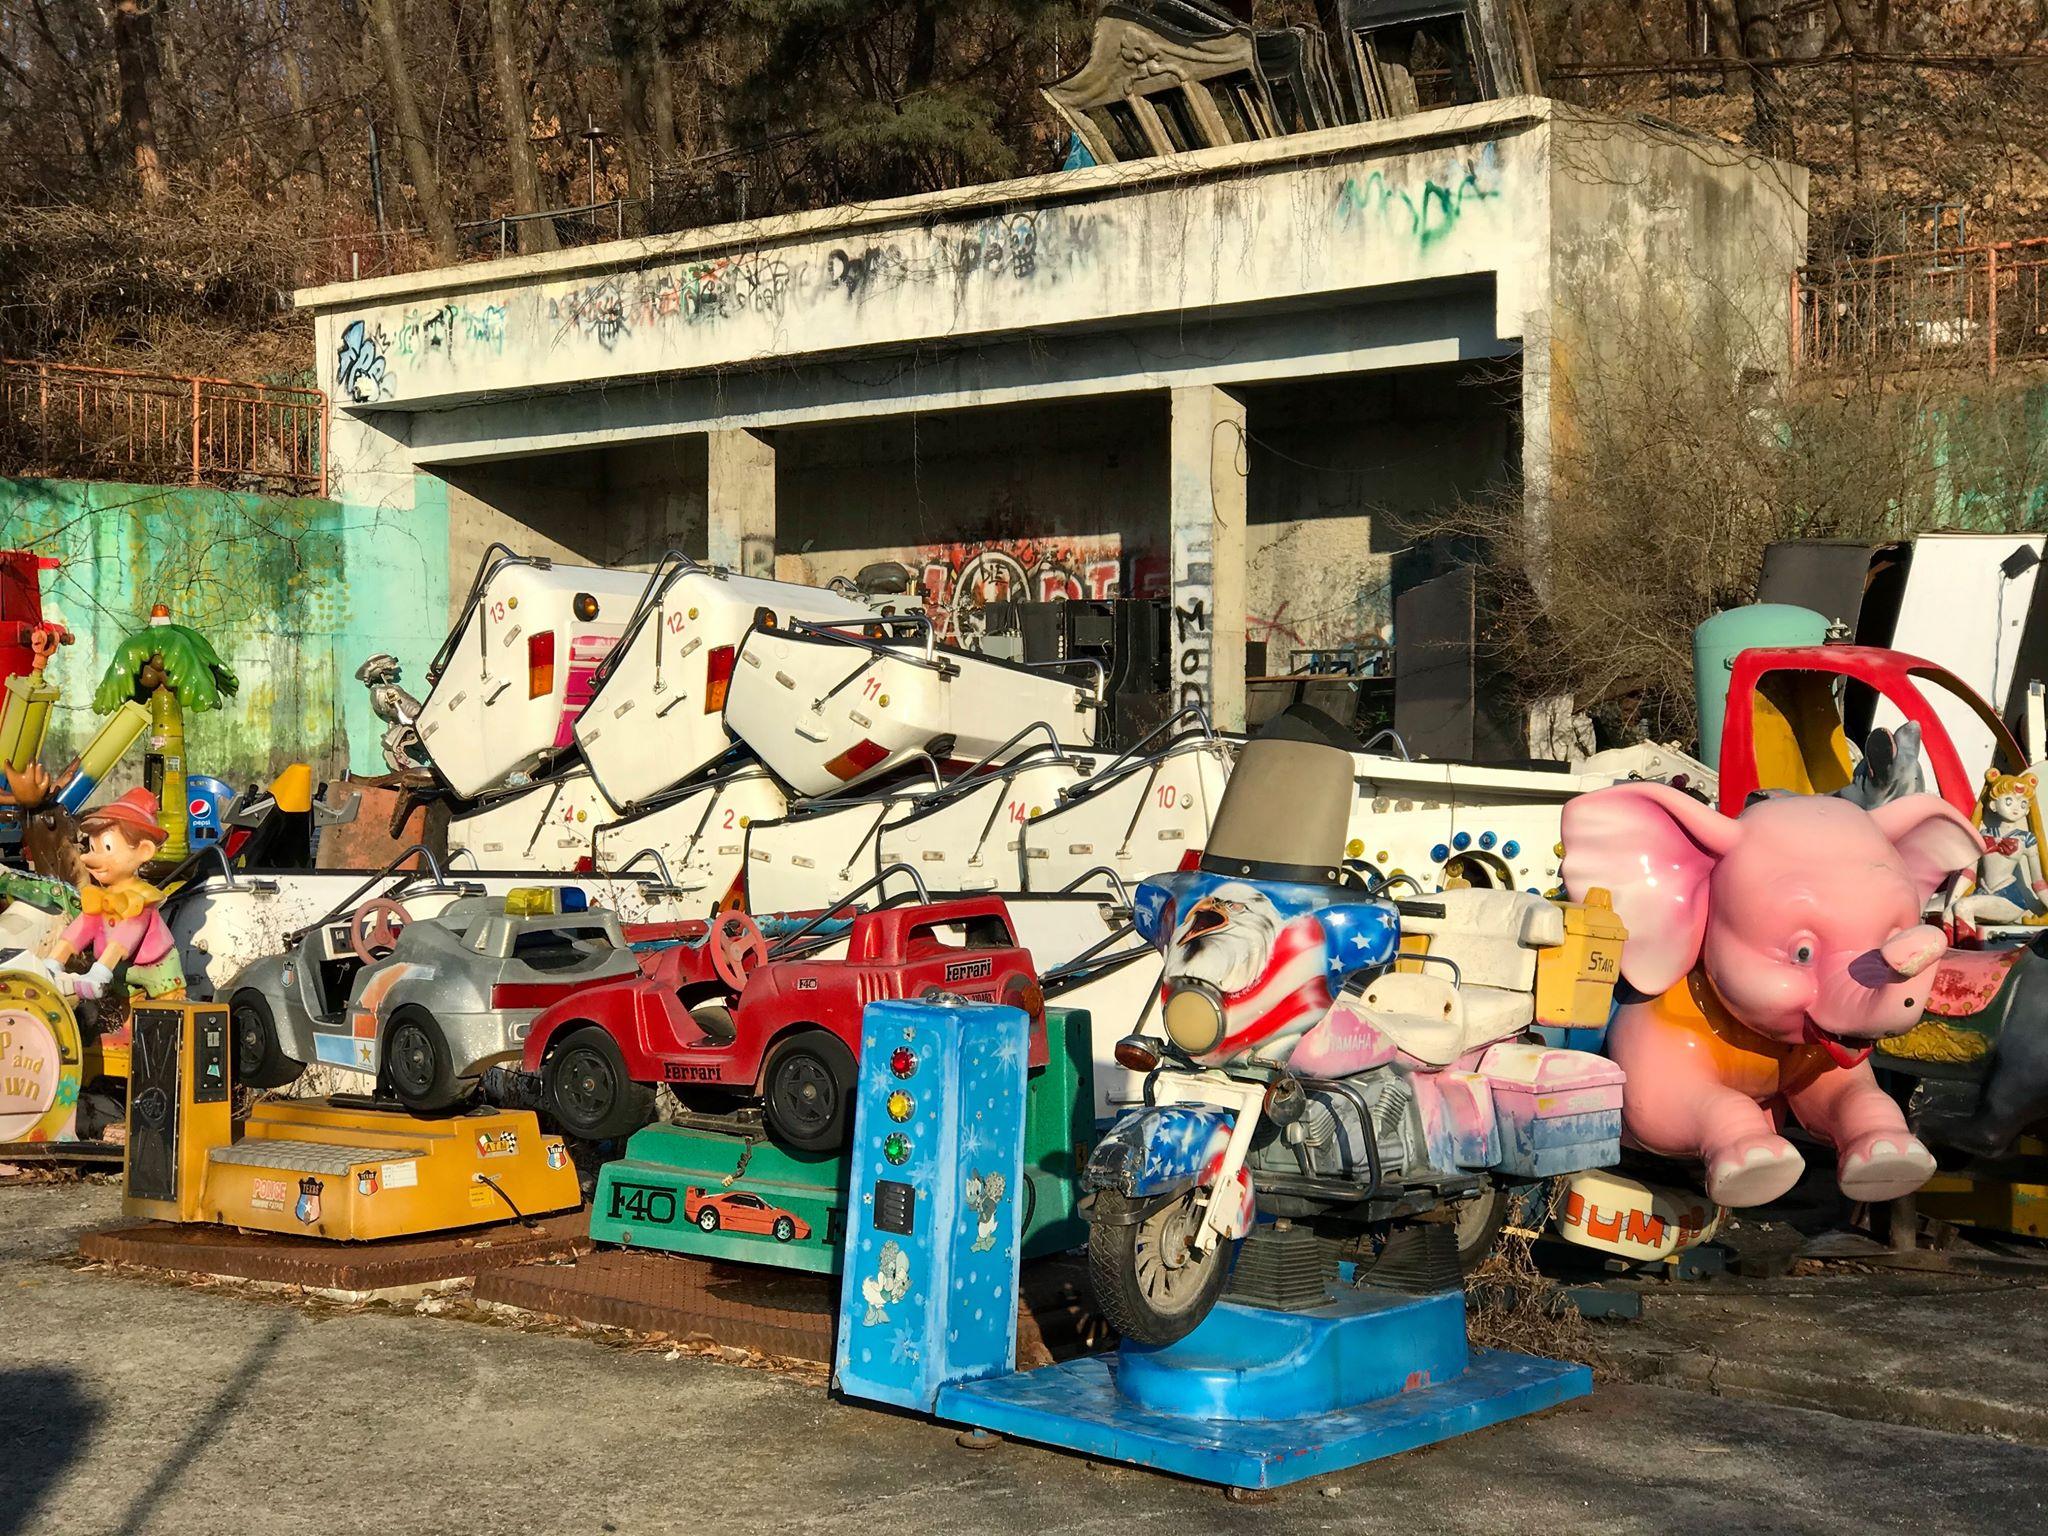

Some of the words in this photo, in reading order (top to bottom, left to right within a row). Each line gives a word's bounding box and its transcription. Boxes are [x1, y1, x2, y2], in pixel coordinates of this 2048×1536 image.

[981, 564, 1009, 584] DIE
[489, 602, 505, 624] 13
[667, 611, 685, 633] 12
[862, 677, 882, 701] 11
[1156, 785, 1176, 809] 10
[192, 819, 211, 827] pepsi
[564, 805, 574, 823] 4
[723, 809, 735, 830] 2
[1008, 801, 1025, 824] 14
[946, 961, 991, 982] Ferrari
[799, 978, 817, 989] F40
[1329, 1033, 1372, 1052] YAMAHA
[13, 1055, 45, 1074] and
[664, 1062, 722, 1081] Ferrari
[252, 1178, 288, 1201] POLICE
[302, 1184, 320, 1195] TEXAS
[607, 1182, 678, 1224] F40
